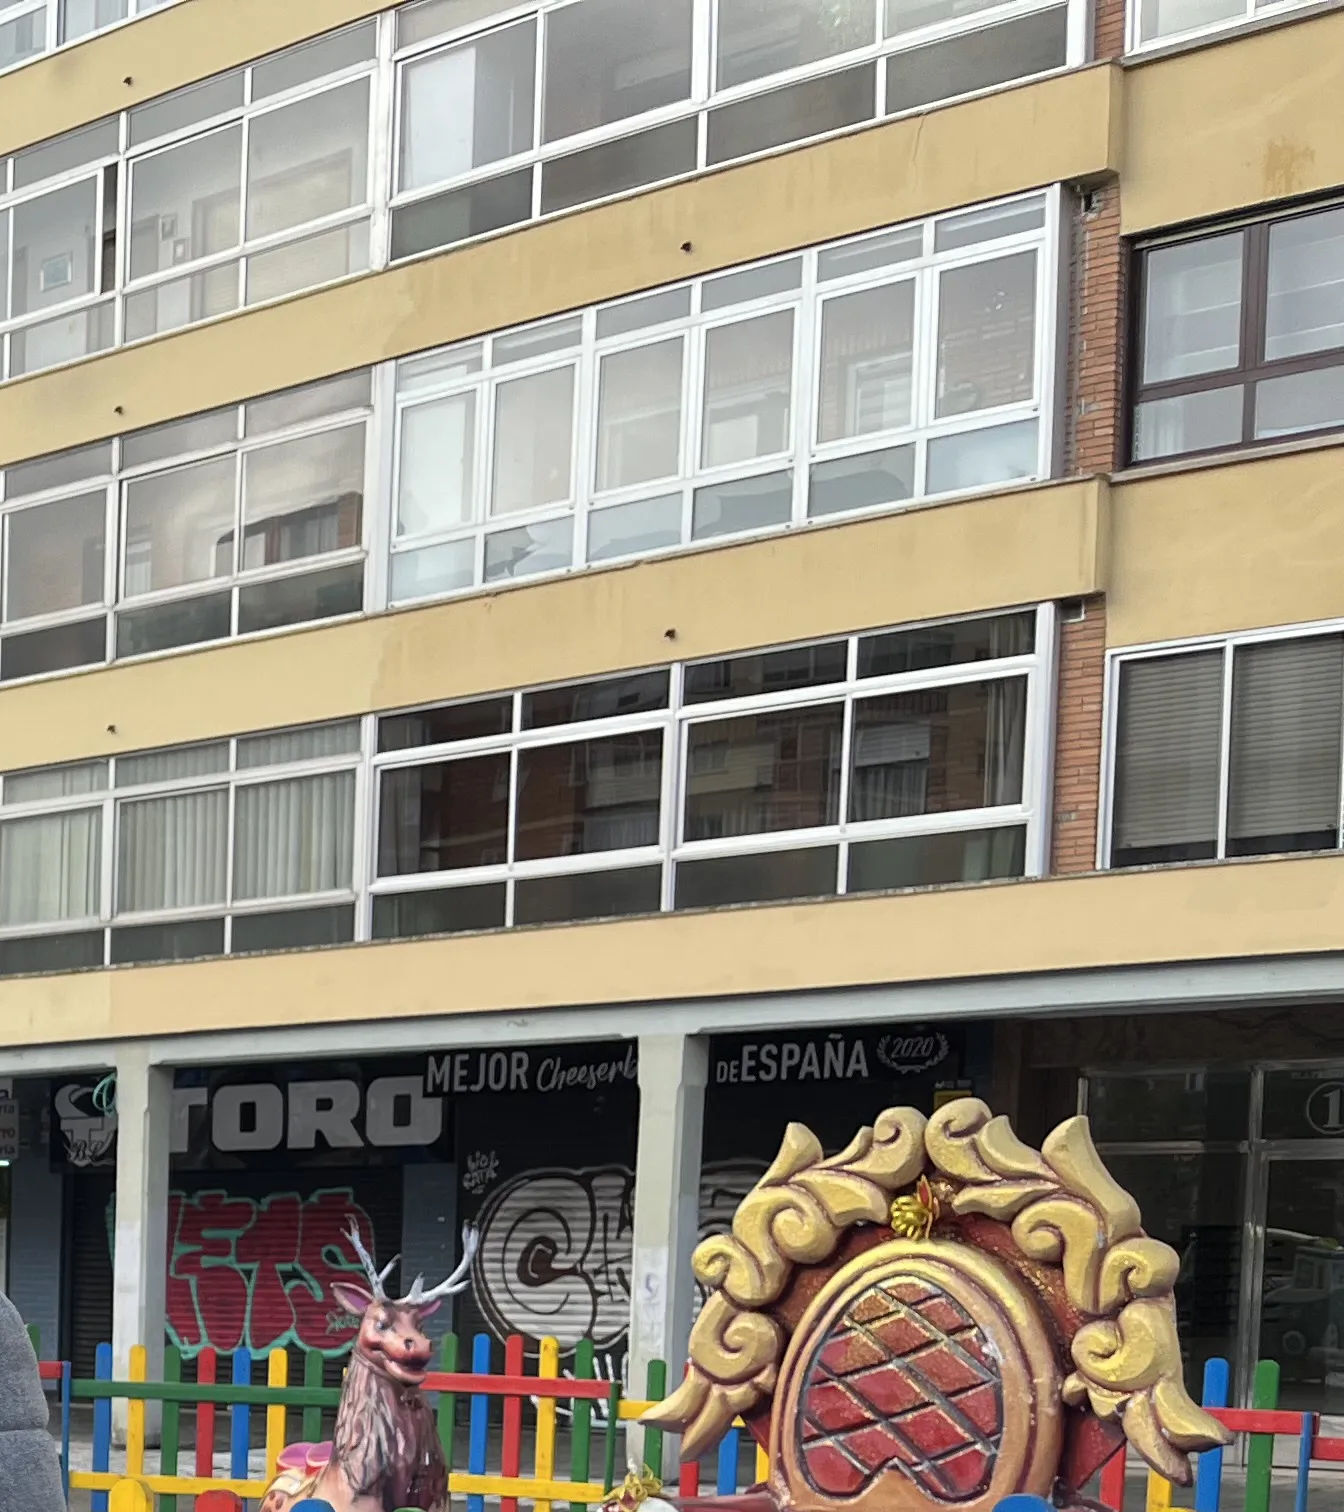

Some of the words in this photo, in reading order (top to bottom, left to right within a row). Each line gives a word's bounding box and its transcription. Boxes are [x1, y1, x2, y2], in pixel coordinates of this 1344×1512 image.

[426, 1052, 530, 1093] MEJOR
[716, 1060, 740, 1083] DE
[740, 1033, 869, 1082] ESPAÑA
[890, 1036, 935, 1058] 2020
